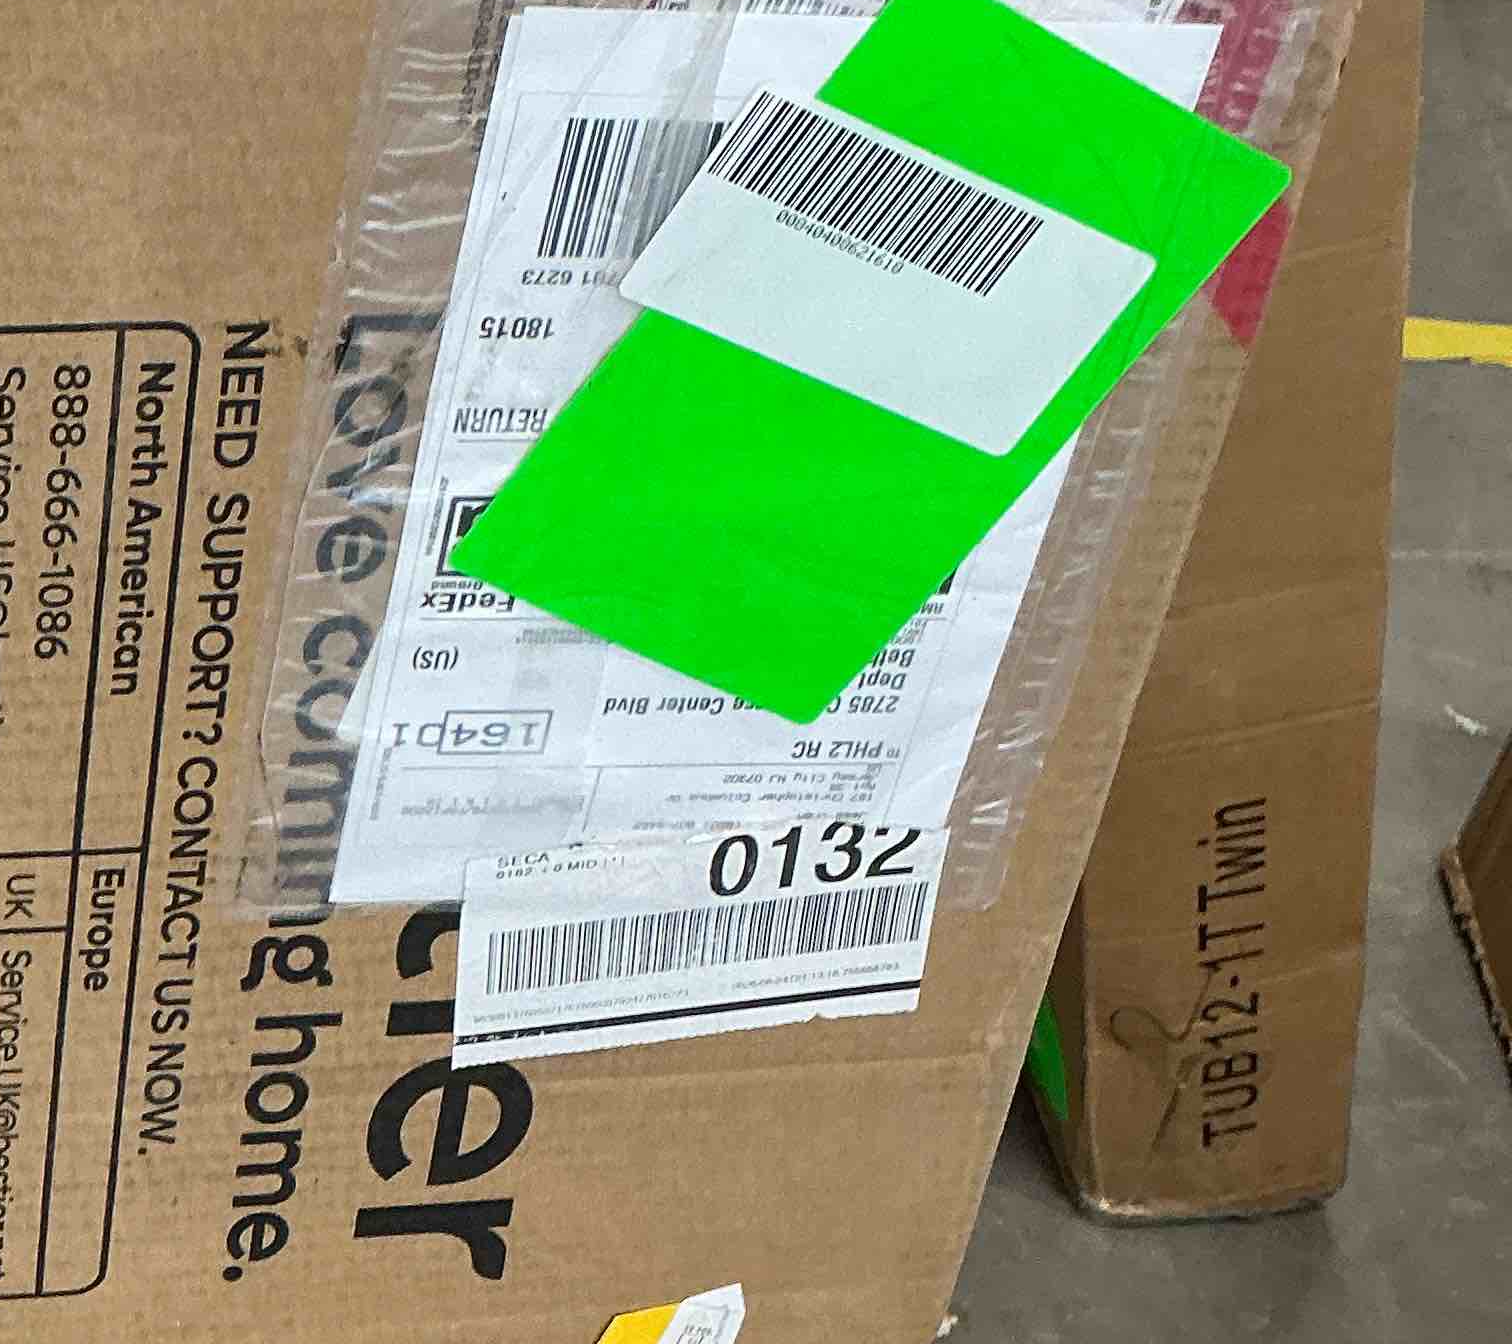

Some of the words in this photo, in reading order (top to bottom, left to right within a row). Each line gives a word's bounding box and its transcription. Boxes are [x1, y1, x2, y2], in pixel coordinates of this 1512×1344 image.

[521, 269, 573, 287] 6273
[479, 315, 555, 340] 18015
[211, 321, 271, 469] NEED
[452, 407, 549, 434] RETURN
[129, 361, 176, 488] North
[34, 364, 91, 660] 888-666-1086
[111, 499, 163, 697] American
[179, 493, 251, 747] SUPPORT?
[417, 591, 517, 614] FedEx
[412, 645, 460, 671] (US)
[603, 696, 651, 716] Blvd
[654, 696, 726, 715] Center
[848, 695, 901, 714] 2785
[829, 740, 885, 759] PHL2
[769, 774, 788, 785] NJ
[151, 757, 217, 974] CONTACT
[709, 821, 922, 897] 0132
[1197, 796, 1267, 913] Twin
[2, 873, 36, 920] UK
[80, 867, 127, 991] Europe
[152, 979, 192, 1032] US
[136, 1039, 188, 1158] NOW.
[224, 1012, 344, 1284] home.
